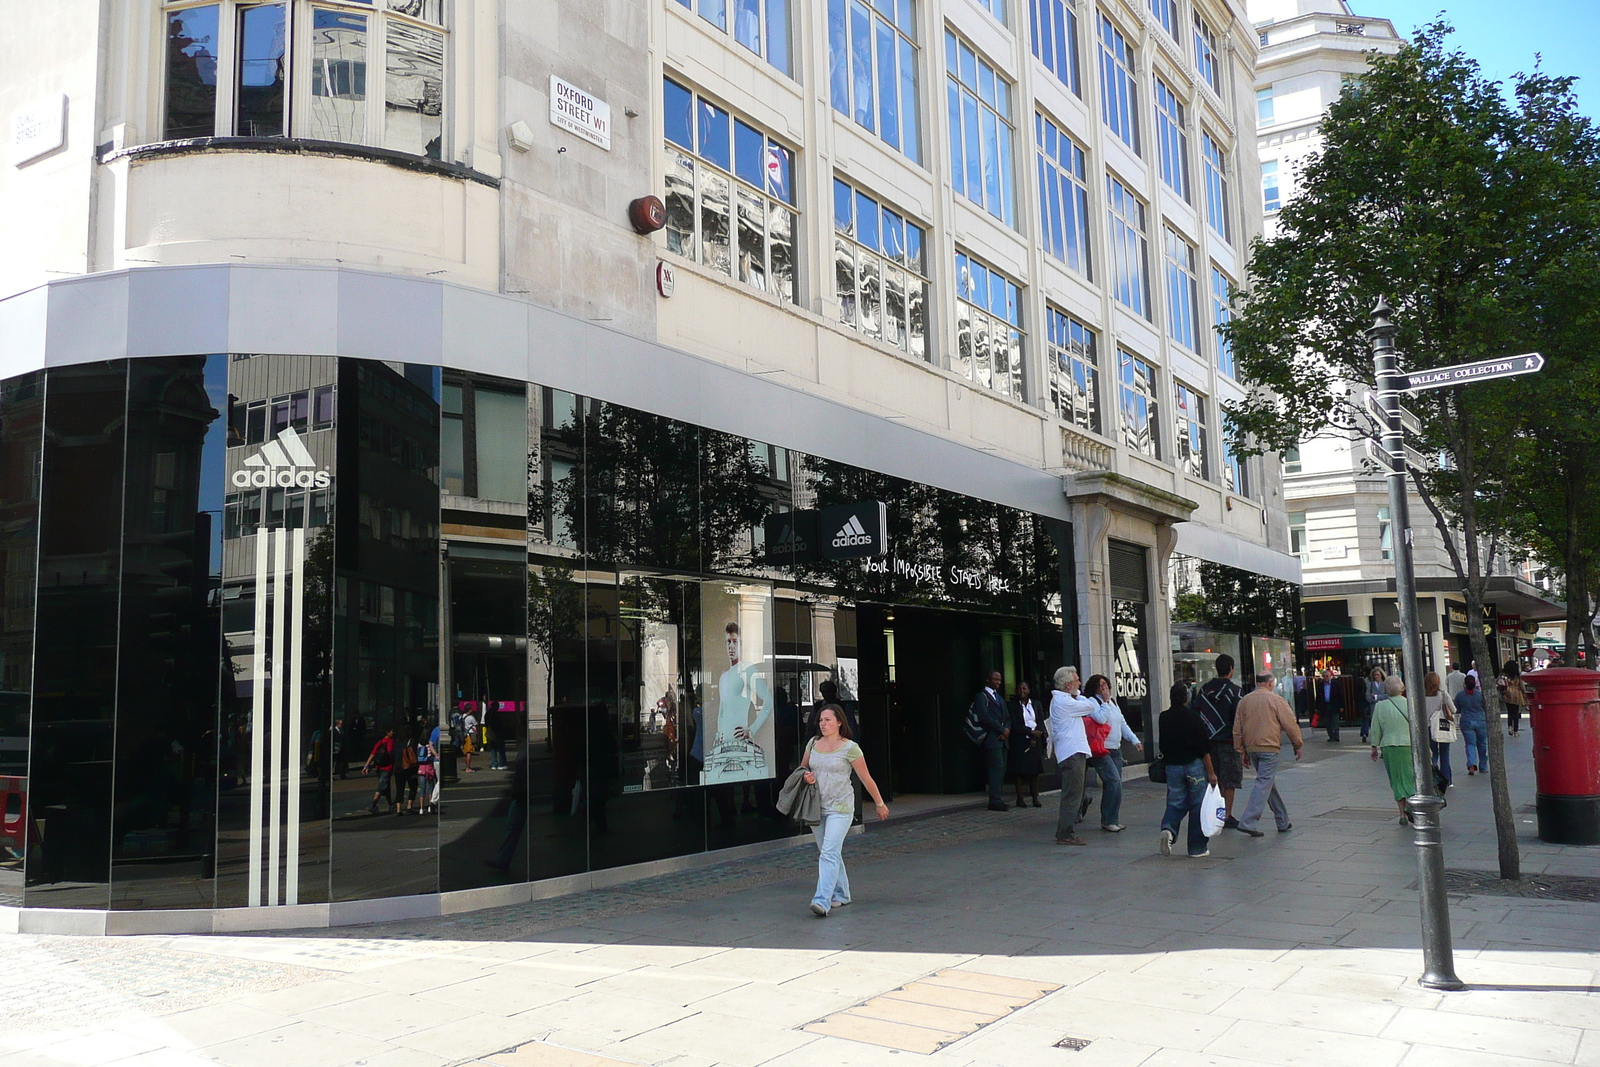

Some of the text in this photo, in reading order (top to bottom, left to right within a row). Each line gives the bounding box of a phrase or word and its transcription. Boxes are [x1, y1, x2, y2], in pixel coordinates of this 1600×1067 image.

[557, 82, 593, 111] OXFORD
[557, 97, 606, 133] STREET W1
[16, 122, 42, 145] STREET
[557, 116, 567, 125] CITY
[574, 124, 604, 144] WESTMINSTER
[1408, 362, 1513, 386] WALLACE COLLECTION
[231, 465, 331, 488] adidas
[831, 534, 872, 548] adidas
[1116, 671, 1147, 697] didas
